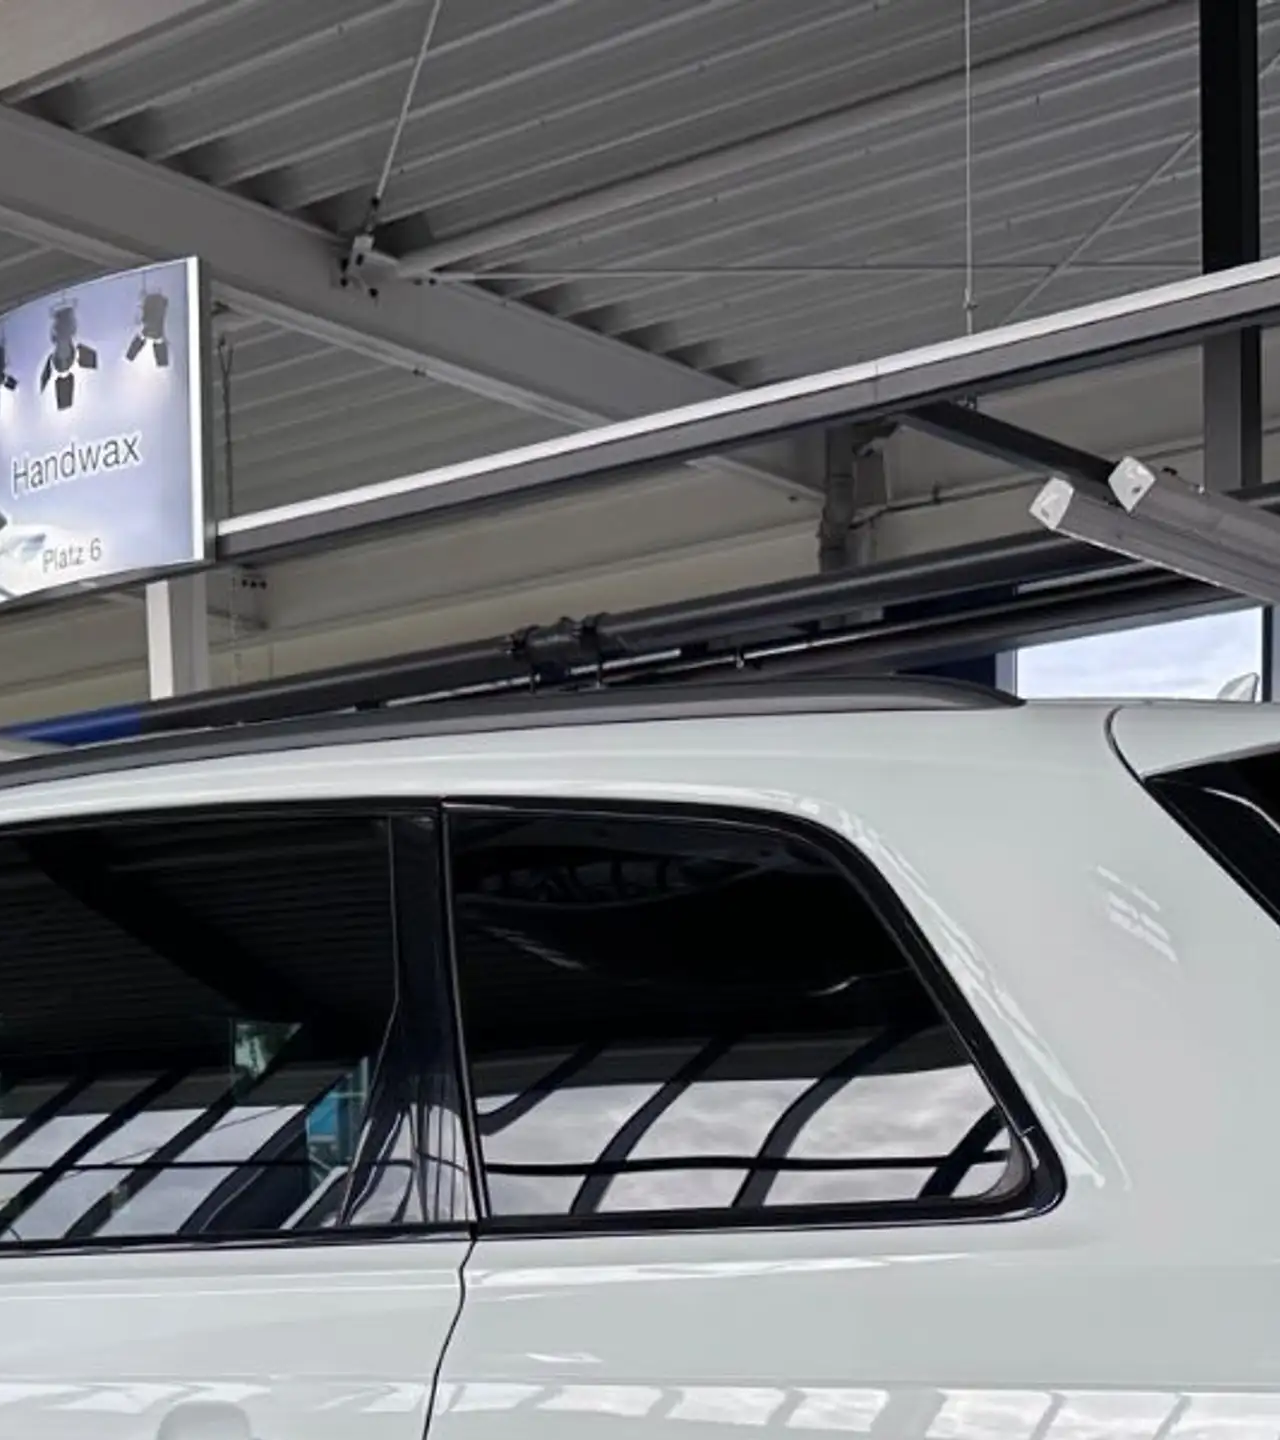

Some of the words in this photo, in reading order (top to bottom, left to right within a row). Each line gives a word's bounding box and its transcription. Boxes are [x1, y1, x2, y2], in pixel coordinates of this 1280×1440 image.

[12, 435, 141, 495] Handwax
[42, 544, 86, 574] Platz
[89, 537, 103, 562] 6
